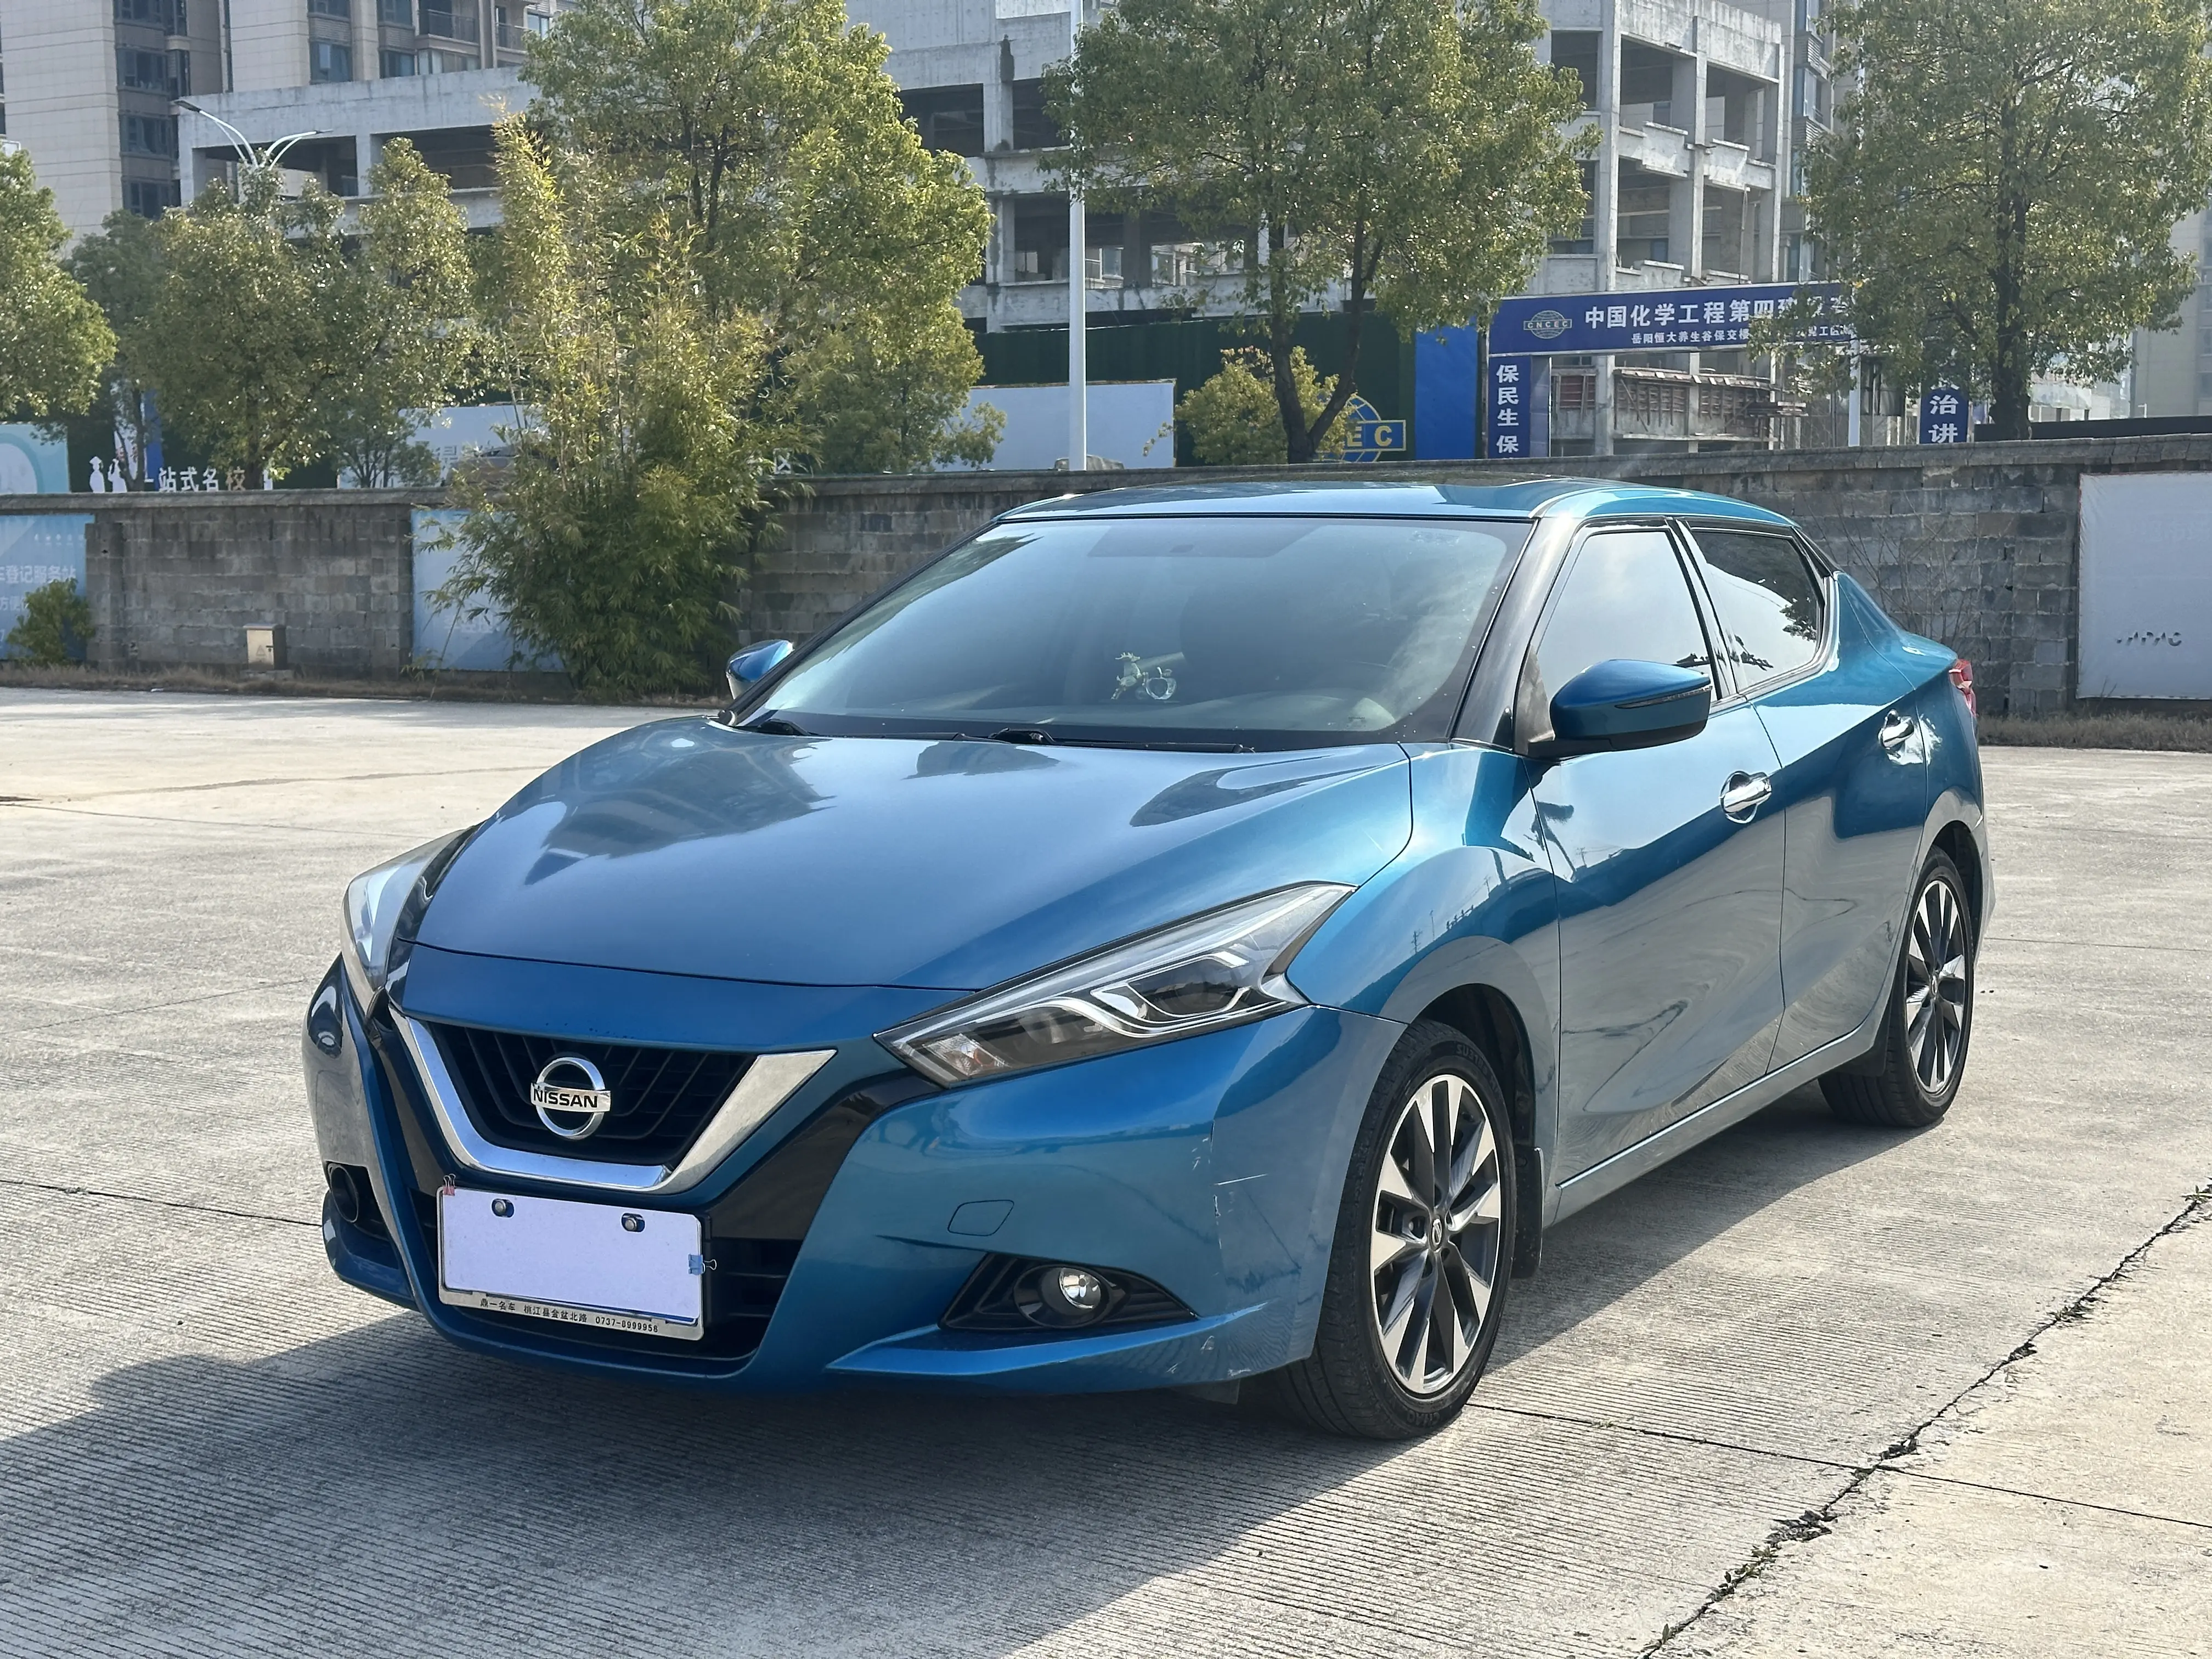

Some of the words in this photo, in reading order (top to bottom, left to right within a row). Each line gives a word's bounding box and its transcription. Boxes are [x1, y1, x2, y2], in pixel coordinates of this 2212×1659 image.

[1527, 320, 1568, 329] CNCEC
[534, 1088, 597, 1108] NISSAN
[480, 1298, 516, 1311] 鼎一名车
